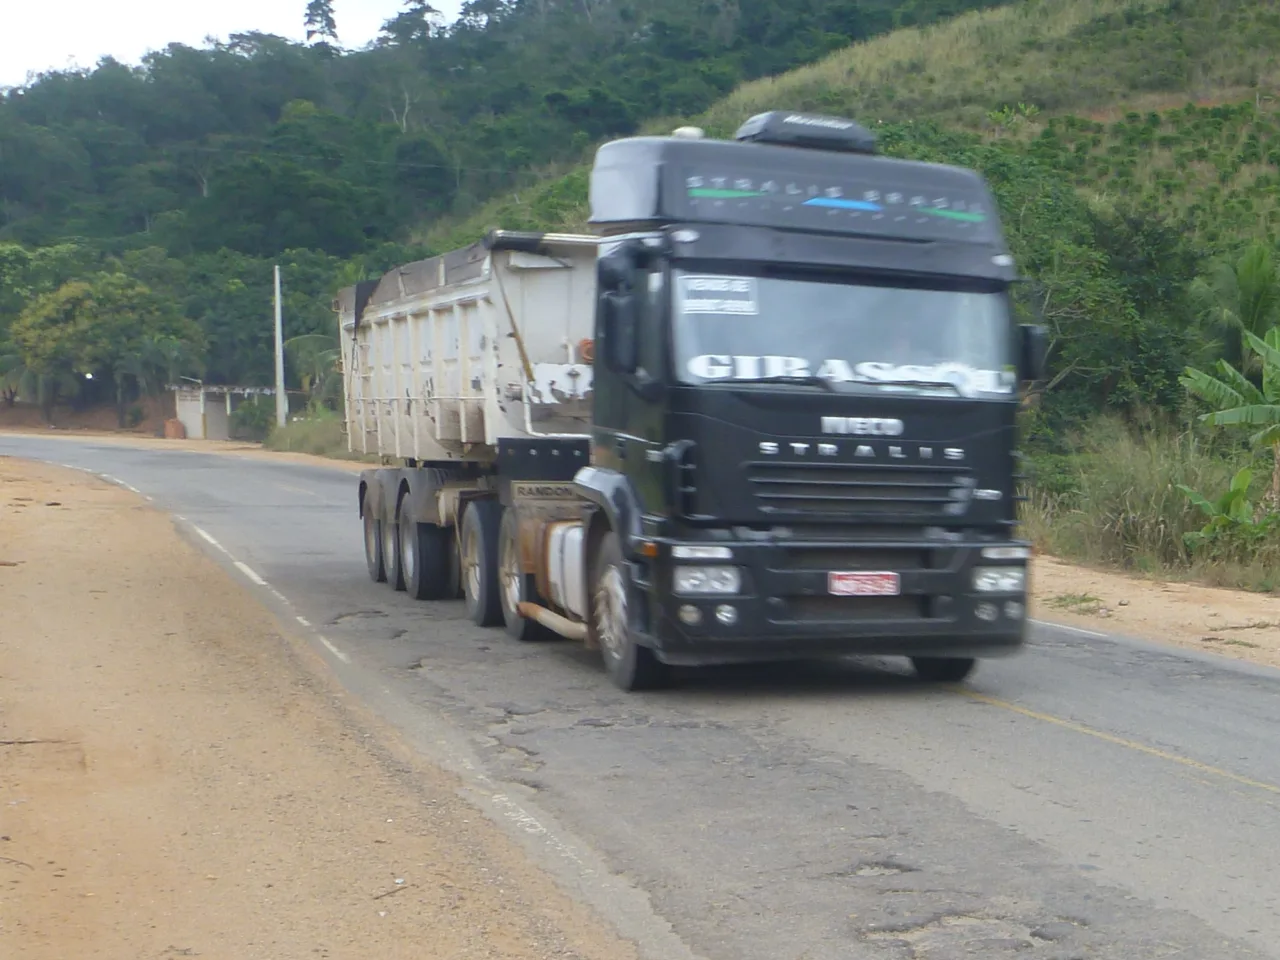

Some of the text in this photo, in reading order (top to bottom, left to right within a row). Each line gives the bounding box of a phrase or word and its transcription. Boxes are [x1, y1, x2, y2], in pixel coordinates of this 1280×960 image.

[686, 175, 842, 198] STRALIS
[758, 441, 965, 460] STRALIS
[517, 486, 573, 496] RANDON
